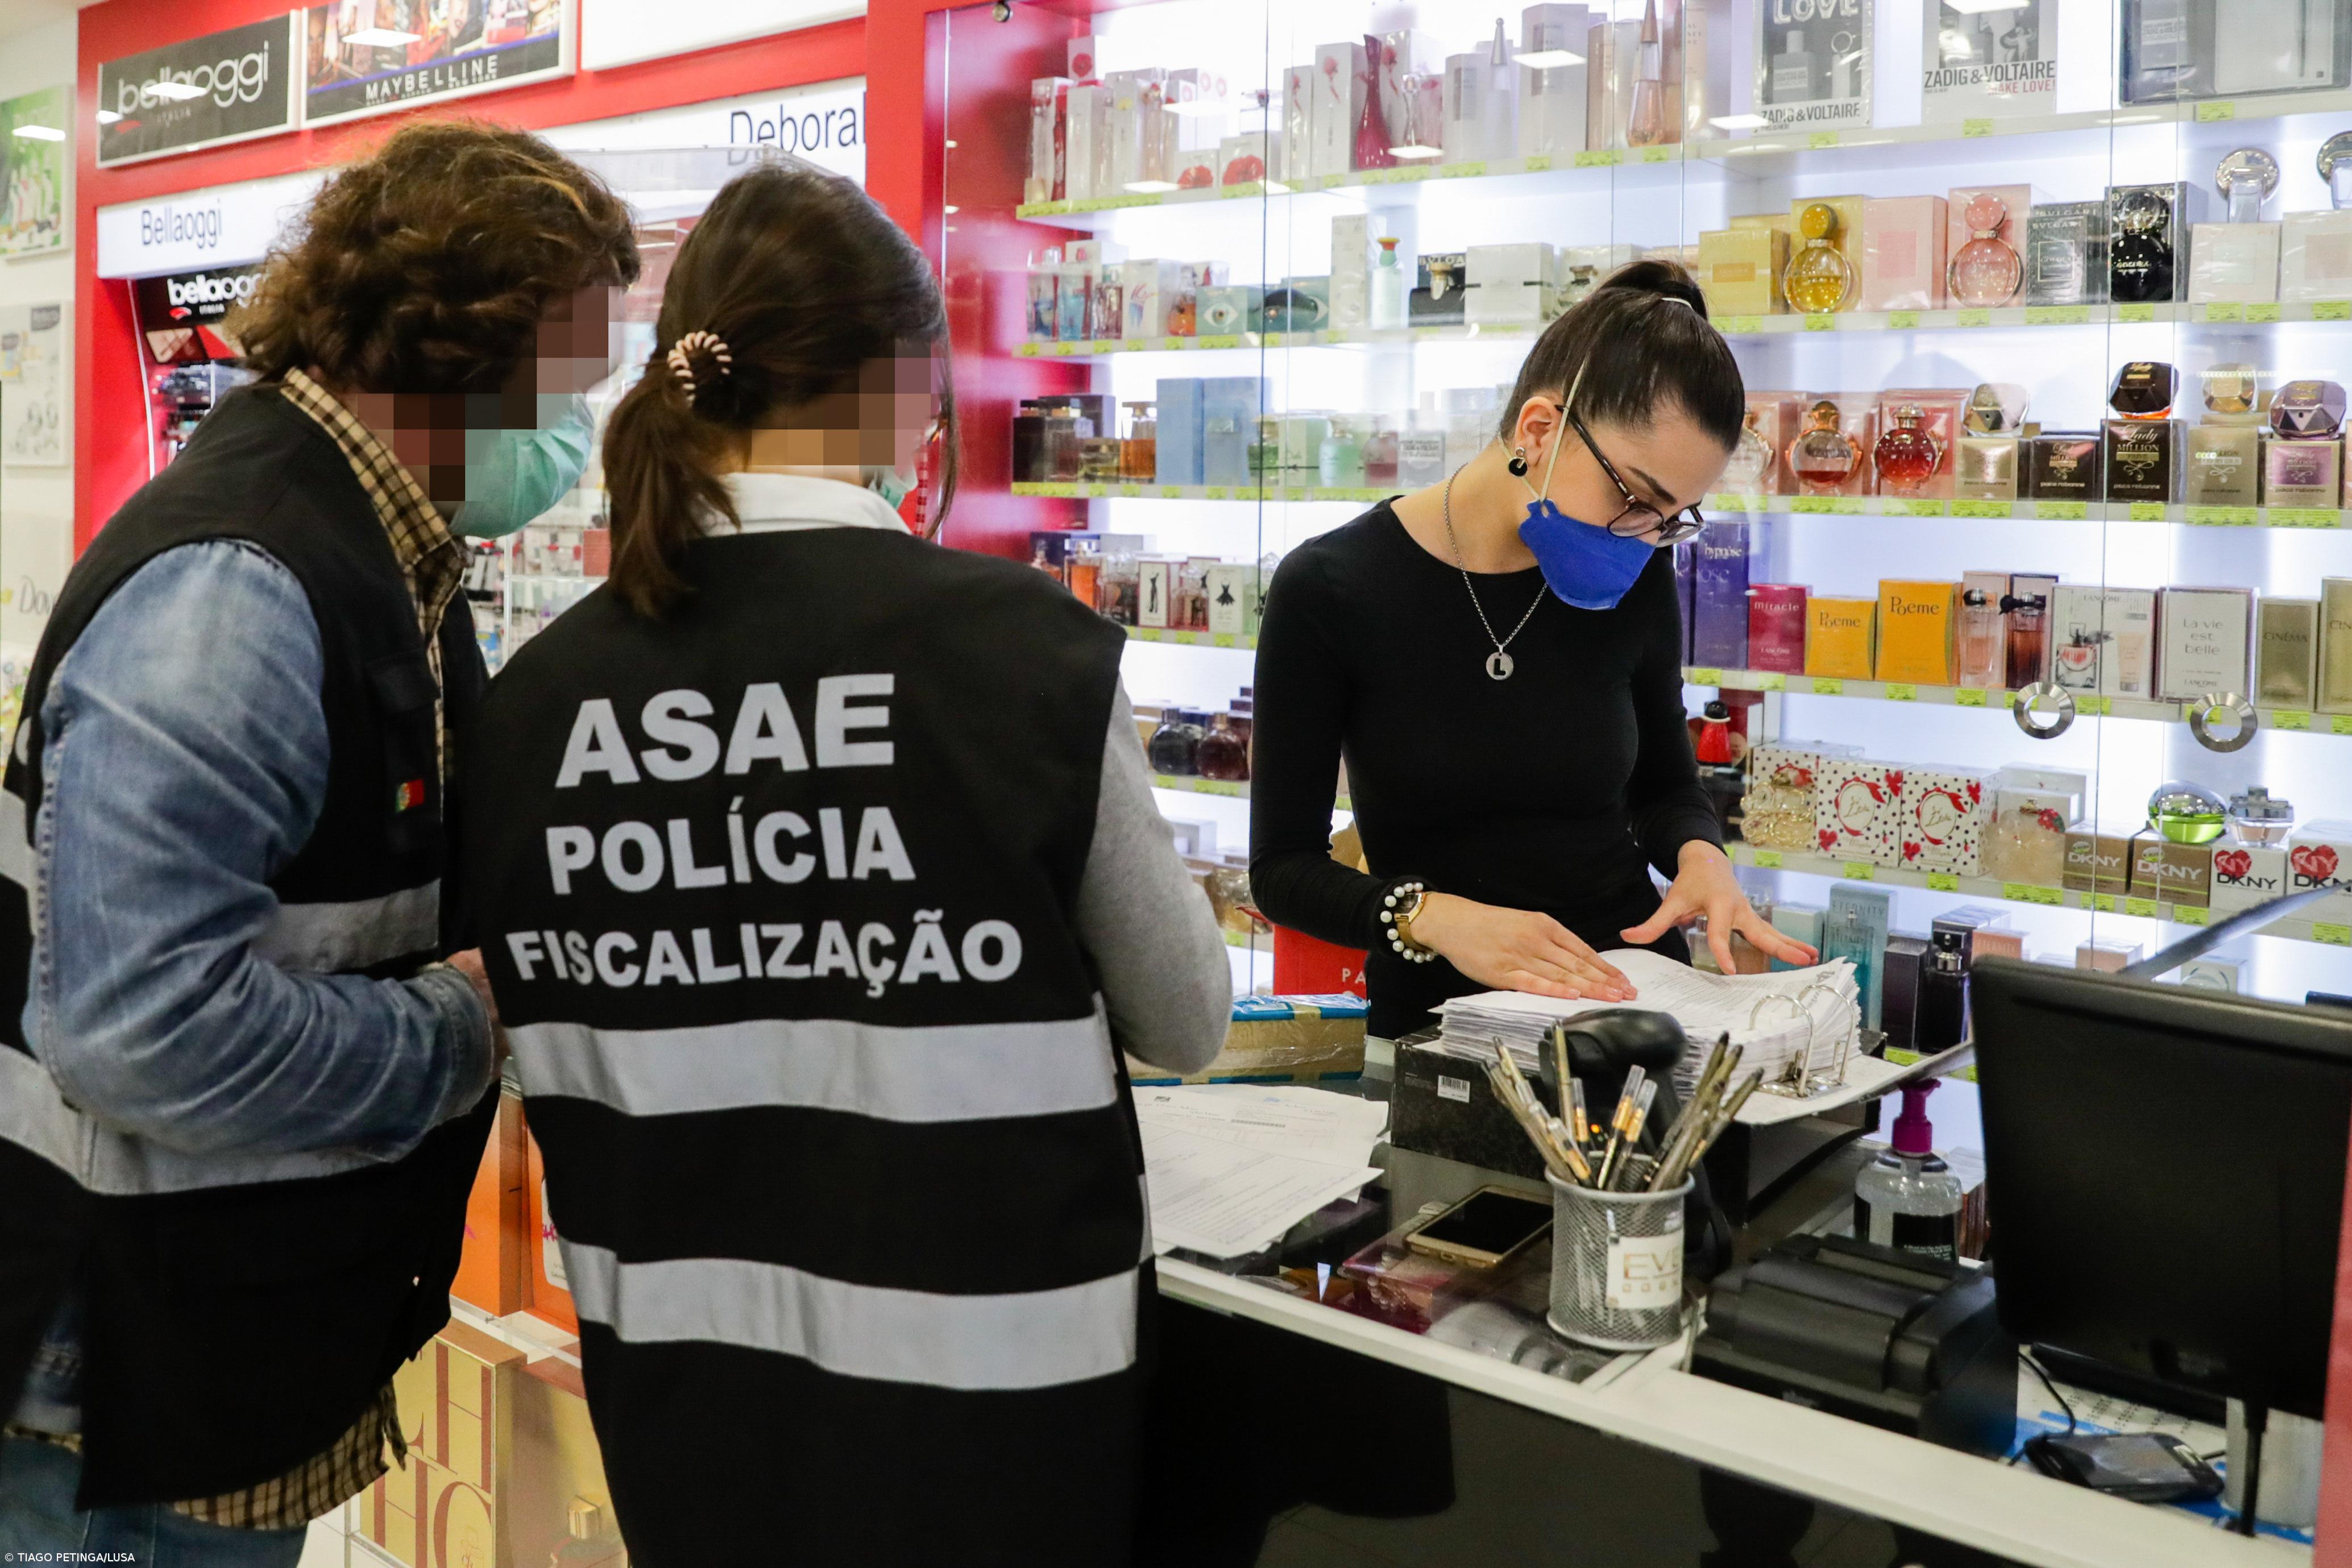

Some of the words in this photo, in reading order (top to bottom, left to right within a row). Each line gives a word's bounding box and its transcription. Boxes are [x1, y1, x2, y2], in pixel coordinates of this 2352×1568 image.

[366, 55, 499, 99] MAYBELLINE
[1924, 69, 1968, 89] ZADIG
[1971, 69, 1983, 84] &
[1984, 60, 2055, 82] VOLTAIRE
[2023, 79, 2056, 93] LOVE!
[1796, 109, 1805, 122] &
[1806, 102, 1860, 121] VOLTAIRE
[728, 91, 866, 165] Debora
[142, 197, 222, 249] Bellaoggi
[2117, 443, 2160, 452] MILLION
[1754, 602, 1800, 612] miracle
[2183, 619, 2197, 628] La
[2204, 619, 2224, 629] vie
[2191, 633, 2216, 641] est
[2185, 643, 2220, 656] belle
[555, 673, 895, 789] ASAE
[545, 797, 916, 895] POLÍCIA
[2068, 852, 2121, 868] DKNY
[2137, 859, 2202, 881] DKNY
[2217, 872, 2278, 890] DKNY
[505, 909, 1023, 998] FISCALIZAÇÃO
